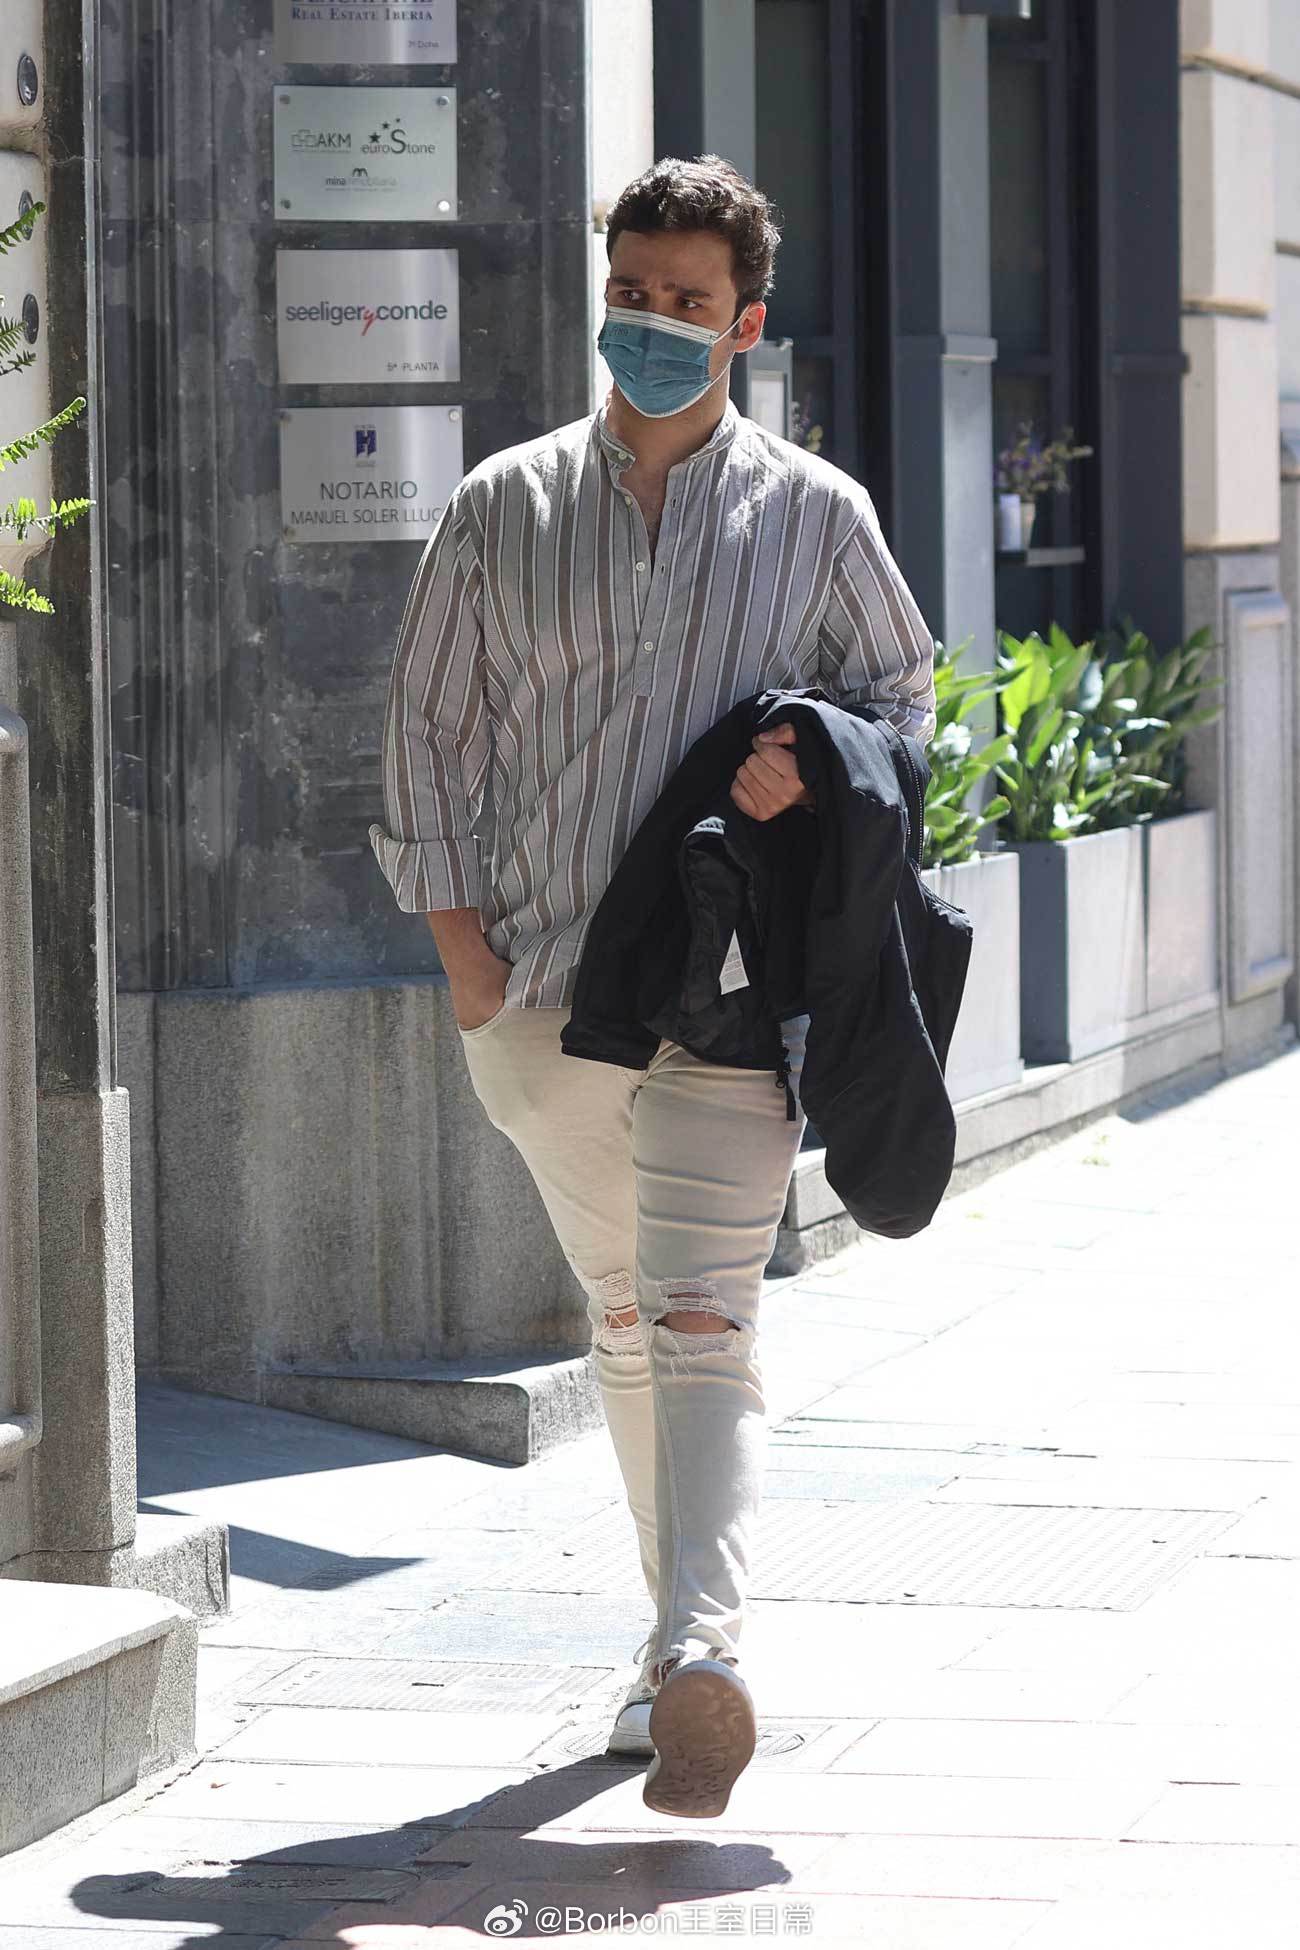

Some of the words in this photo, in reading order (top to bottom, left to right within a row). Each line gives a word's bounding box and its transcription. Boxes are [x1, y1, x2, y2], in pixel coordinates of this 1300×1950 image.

[329, 8, 378, 20] ESTATE
[384, 8, 433, 20] IBERIA
[317, 132, 352, 149] AKM
[402, 361, 440, 372] PLANTA
[320, 480, 418, 500] NOTARIO
[290, 509, 350, 525] MANUEL
[353, 508, 400, 524] SOLER
[404, 507, 443, 523] LLUC
